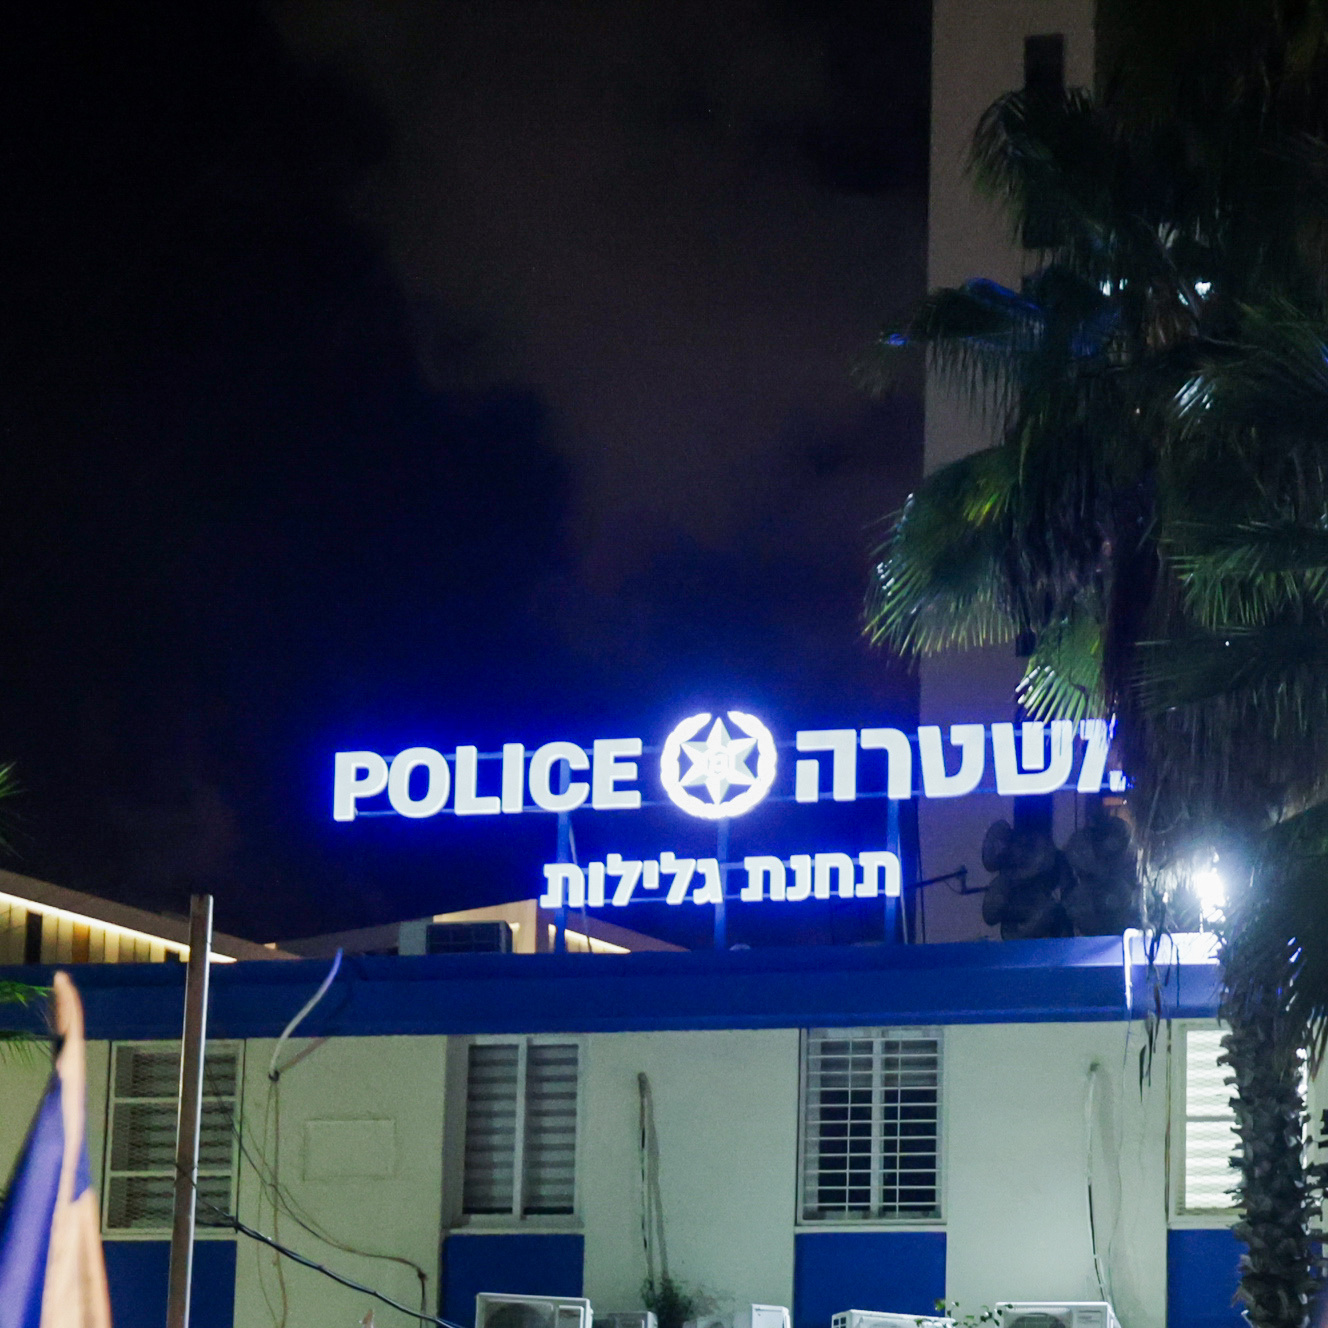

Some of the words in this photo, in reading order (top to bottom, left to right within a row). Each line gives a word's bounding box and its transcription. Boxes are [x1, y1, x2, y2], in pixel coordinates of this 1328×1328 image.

[333, 737, 642, 822] POLICE
[539, 851, 723, 908] גלילות
[740, 850, 901, 902] תחנת
